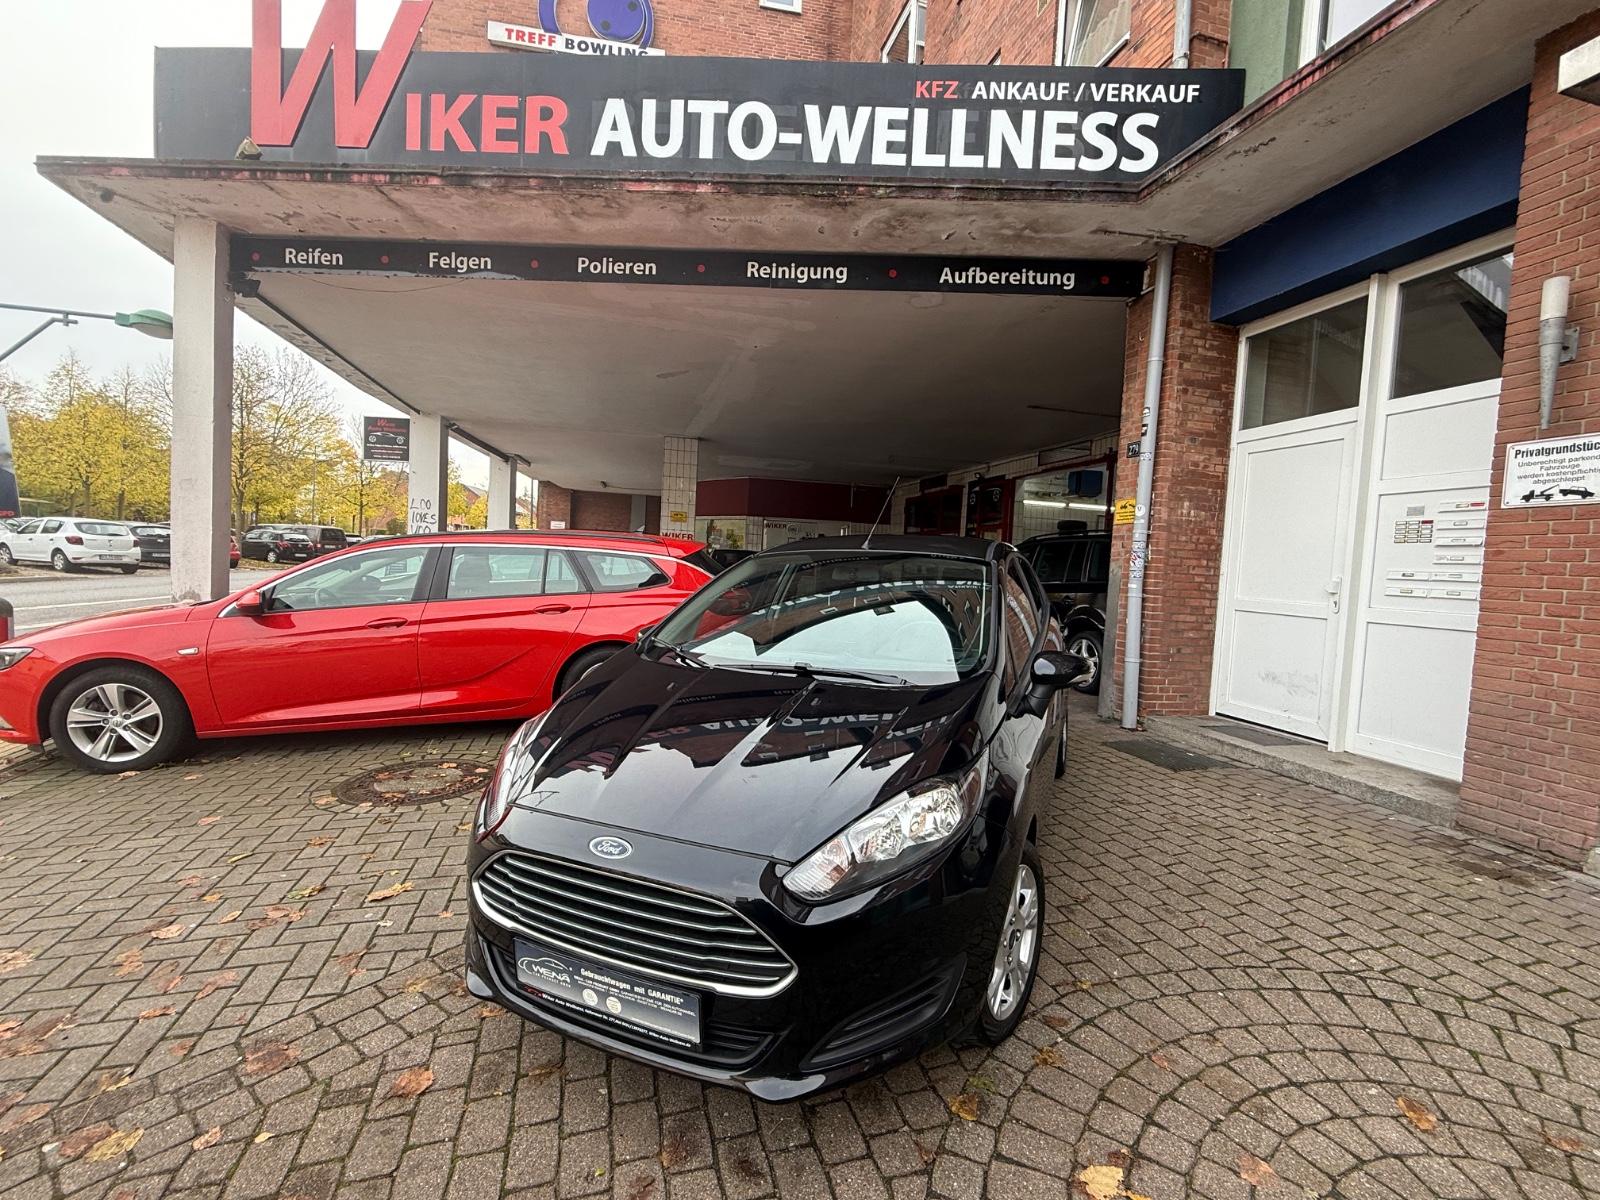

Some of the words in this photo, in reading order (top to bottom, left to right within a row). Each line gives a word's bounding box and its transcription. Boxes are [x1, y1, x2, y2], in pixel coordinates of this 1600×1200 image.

[505, 28, 557, 47] TREFF
[250, 0, 570, 155] WIKER
[590, 98, 1160, 173] AUTO-WELLNESS
[915, 80, 959, 99] KFZ
[971, 81, 1070, 101] ANKAUF
[1091, 83, 1200, 103] VERKAUF
[284, 247, 343, 266] Reifen
[428, 251, 492, 273] Felgen
[576, 256, 657, 276] Polieren
[746, 261, 849, 285] Reinigung
[939, 266, 1076, 291] Aufbereitung
[1518, 458, 1567, 467] Unberechtigt
[1539, 463, 1581, 471] Fahrzeuge
[1517, 471, 1544, 480] werden
[1532, 475, 1586, 485] abgeschleppt
[661, 531, 694, 541] WIKER
[597, 840, 623, 855] Ford
[580, 968, 631, 990] Gebrauchtwagen
[633, 986, 646, 994] mit
